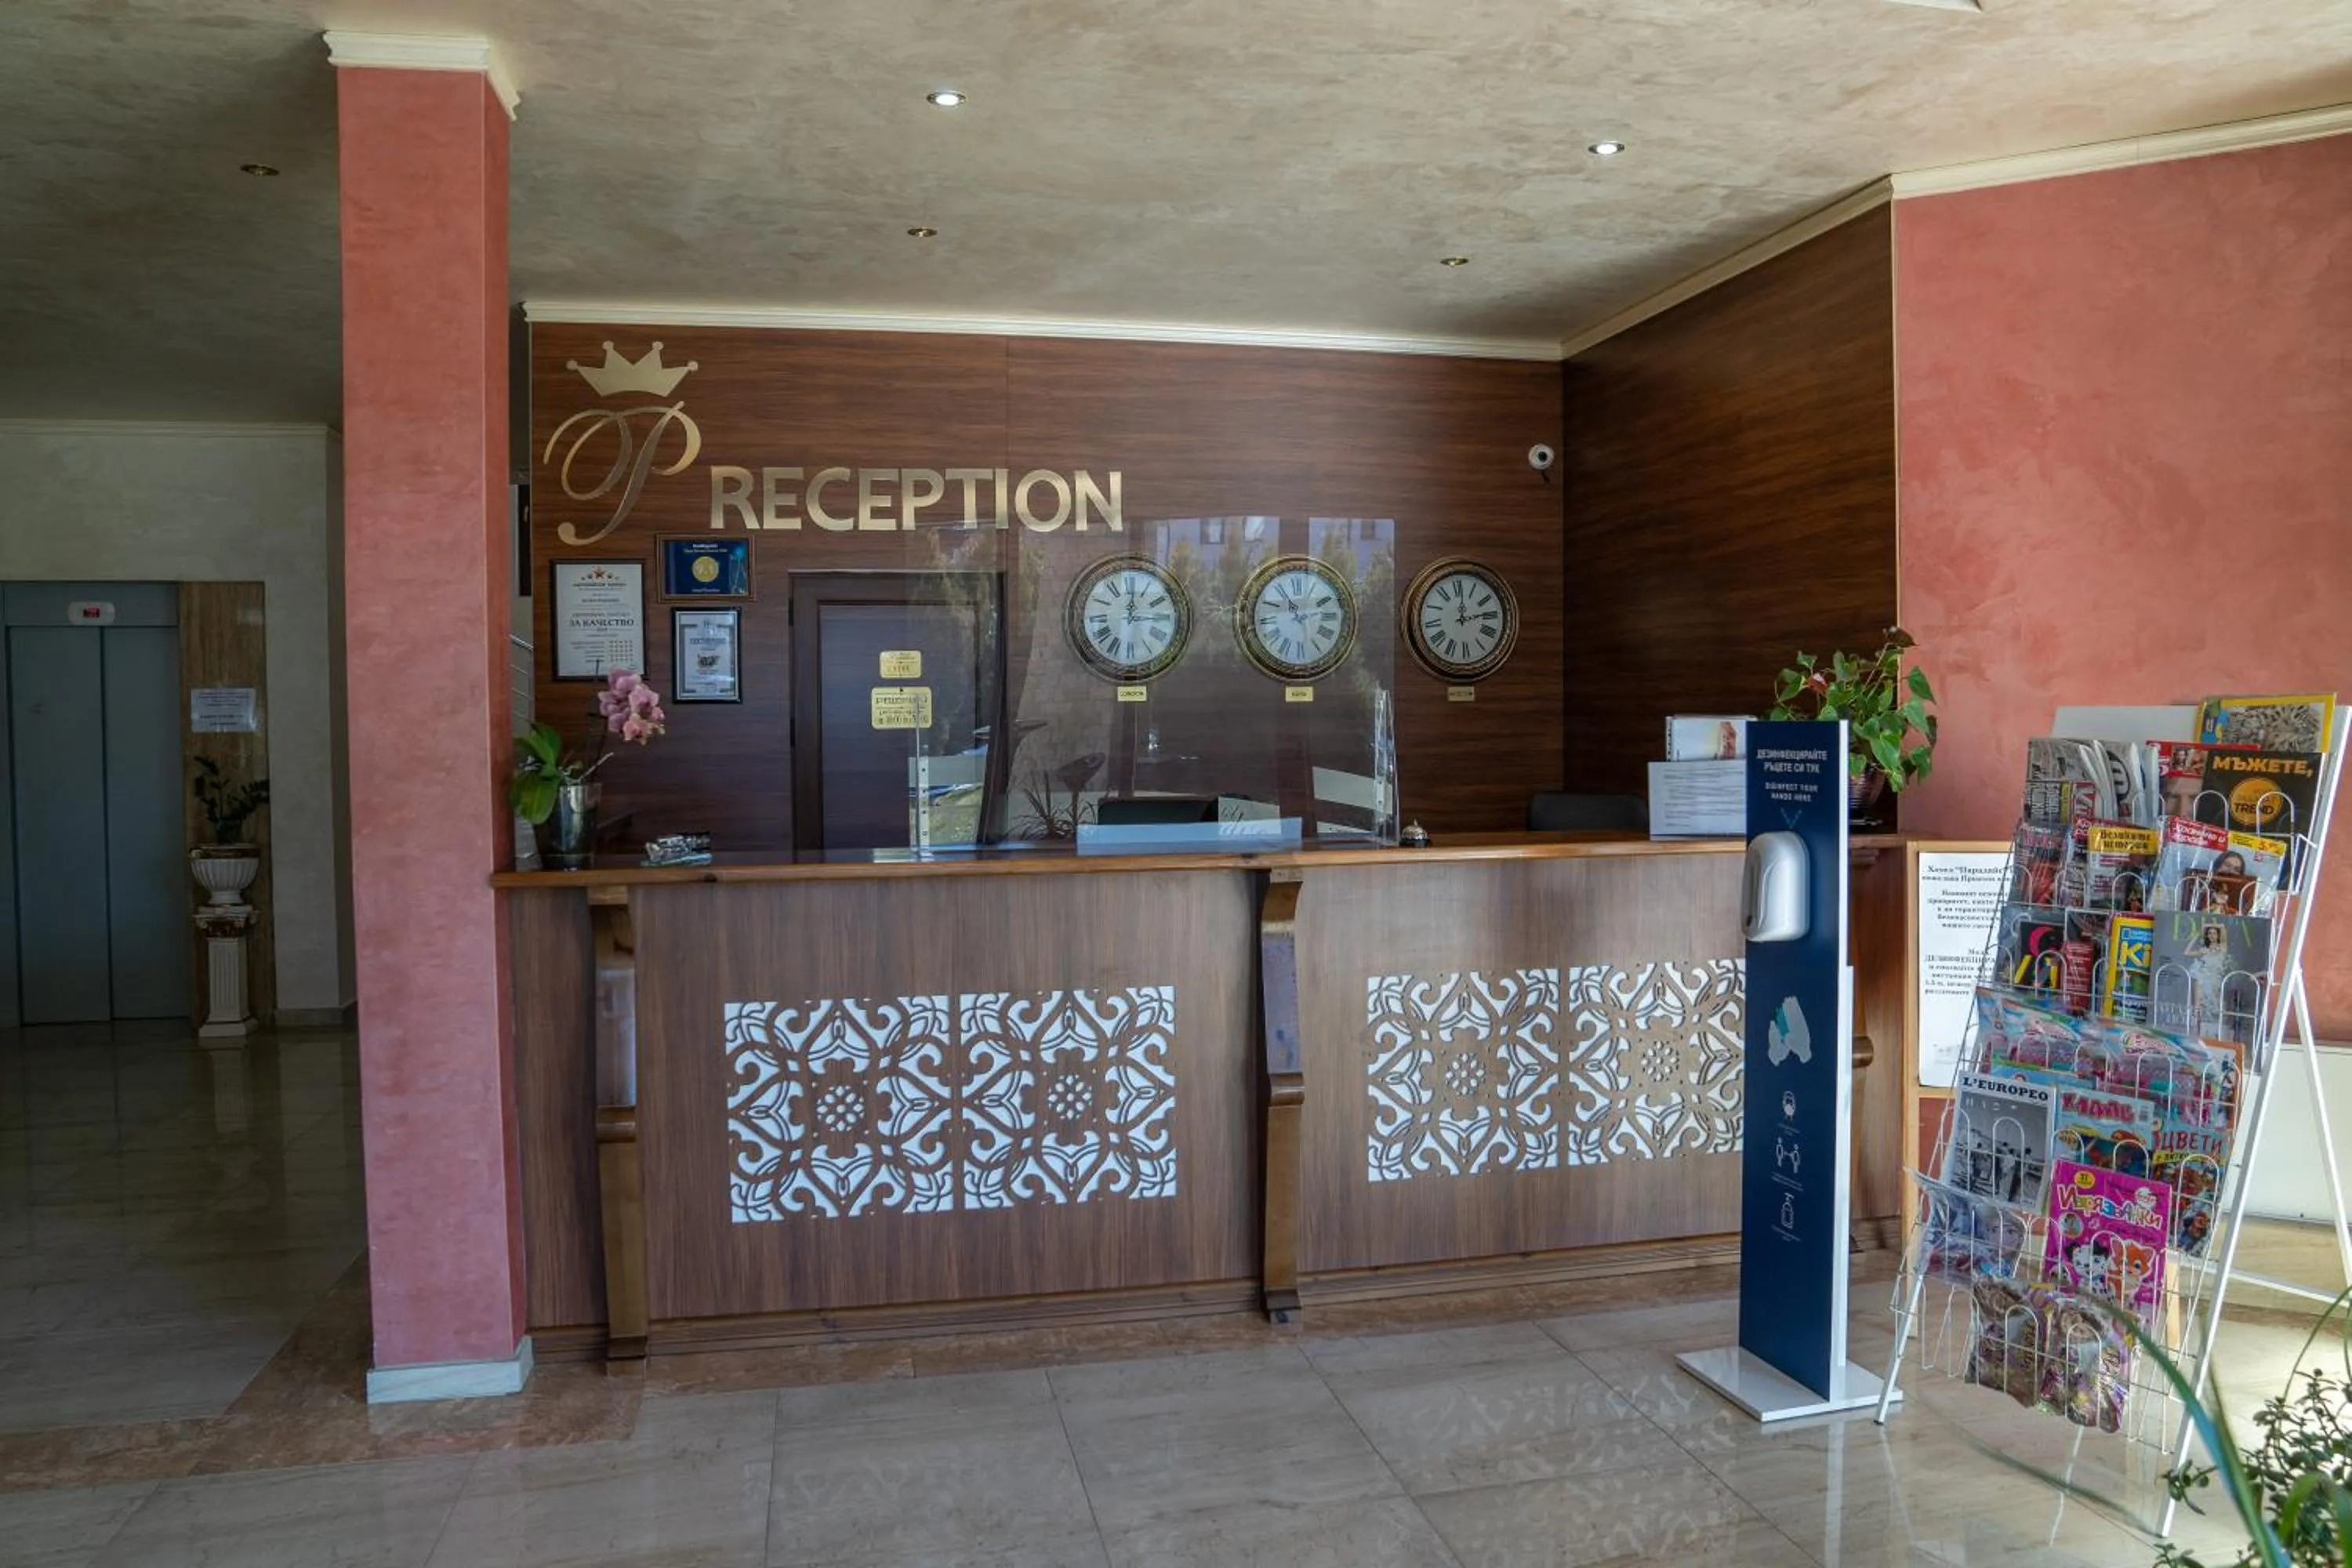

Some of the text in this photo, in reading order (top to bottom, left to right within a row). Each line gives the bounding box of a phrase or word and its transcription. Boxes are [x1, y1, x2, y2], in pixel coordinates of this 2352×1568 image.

[710, 465, 1123, 532] RECEPTION
[2212, 756, 2313, 779] МЪЖЕТЕ,
[2234, 802, 2274, 815] TREND
[1962, 1076, 2049, 1101] L'EUROPEO
